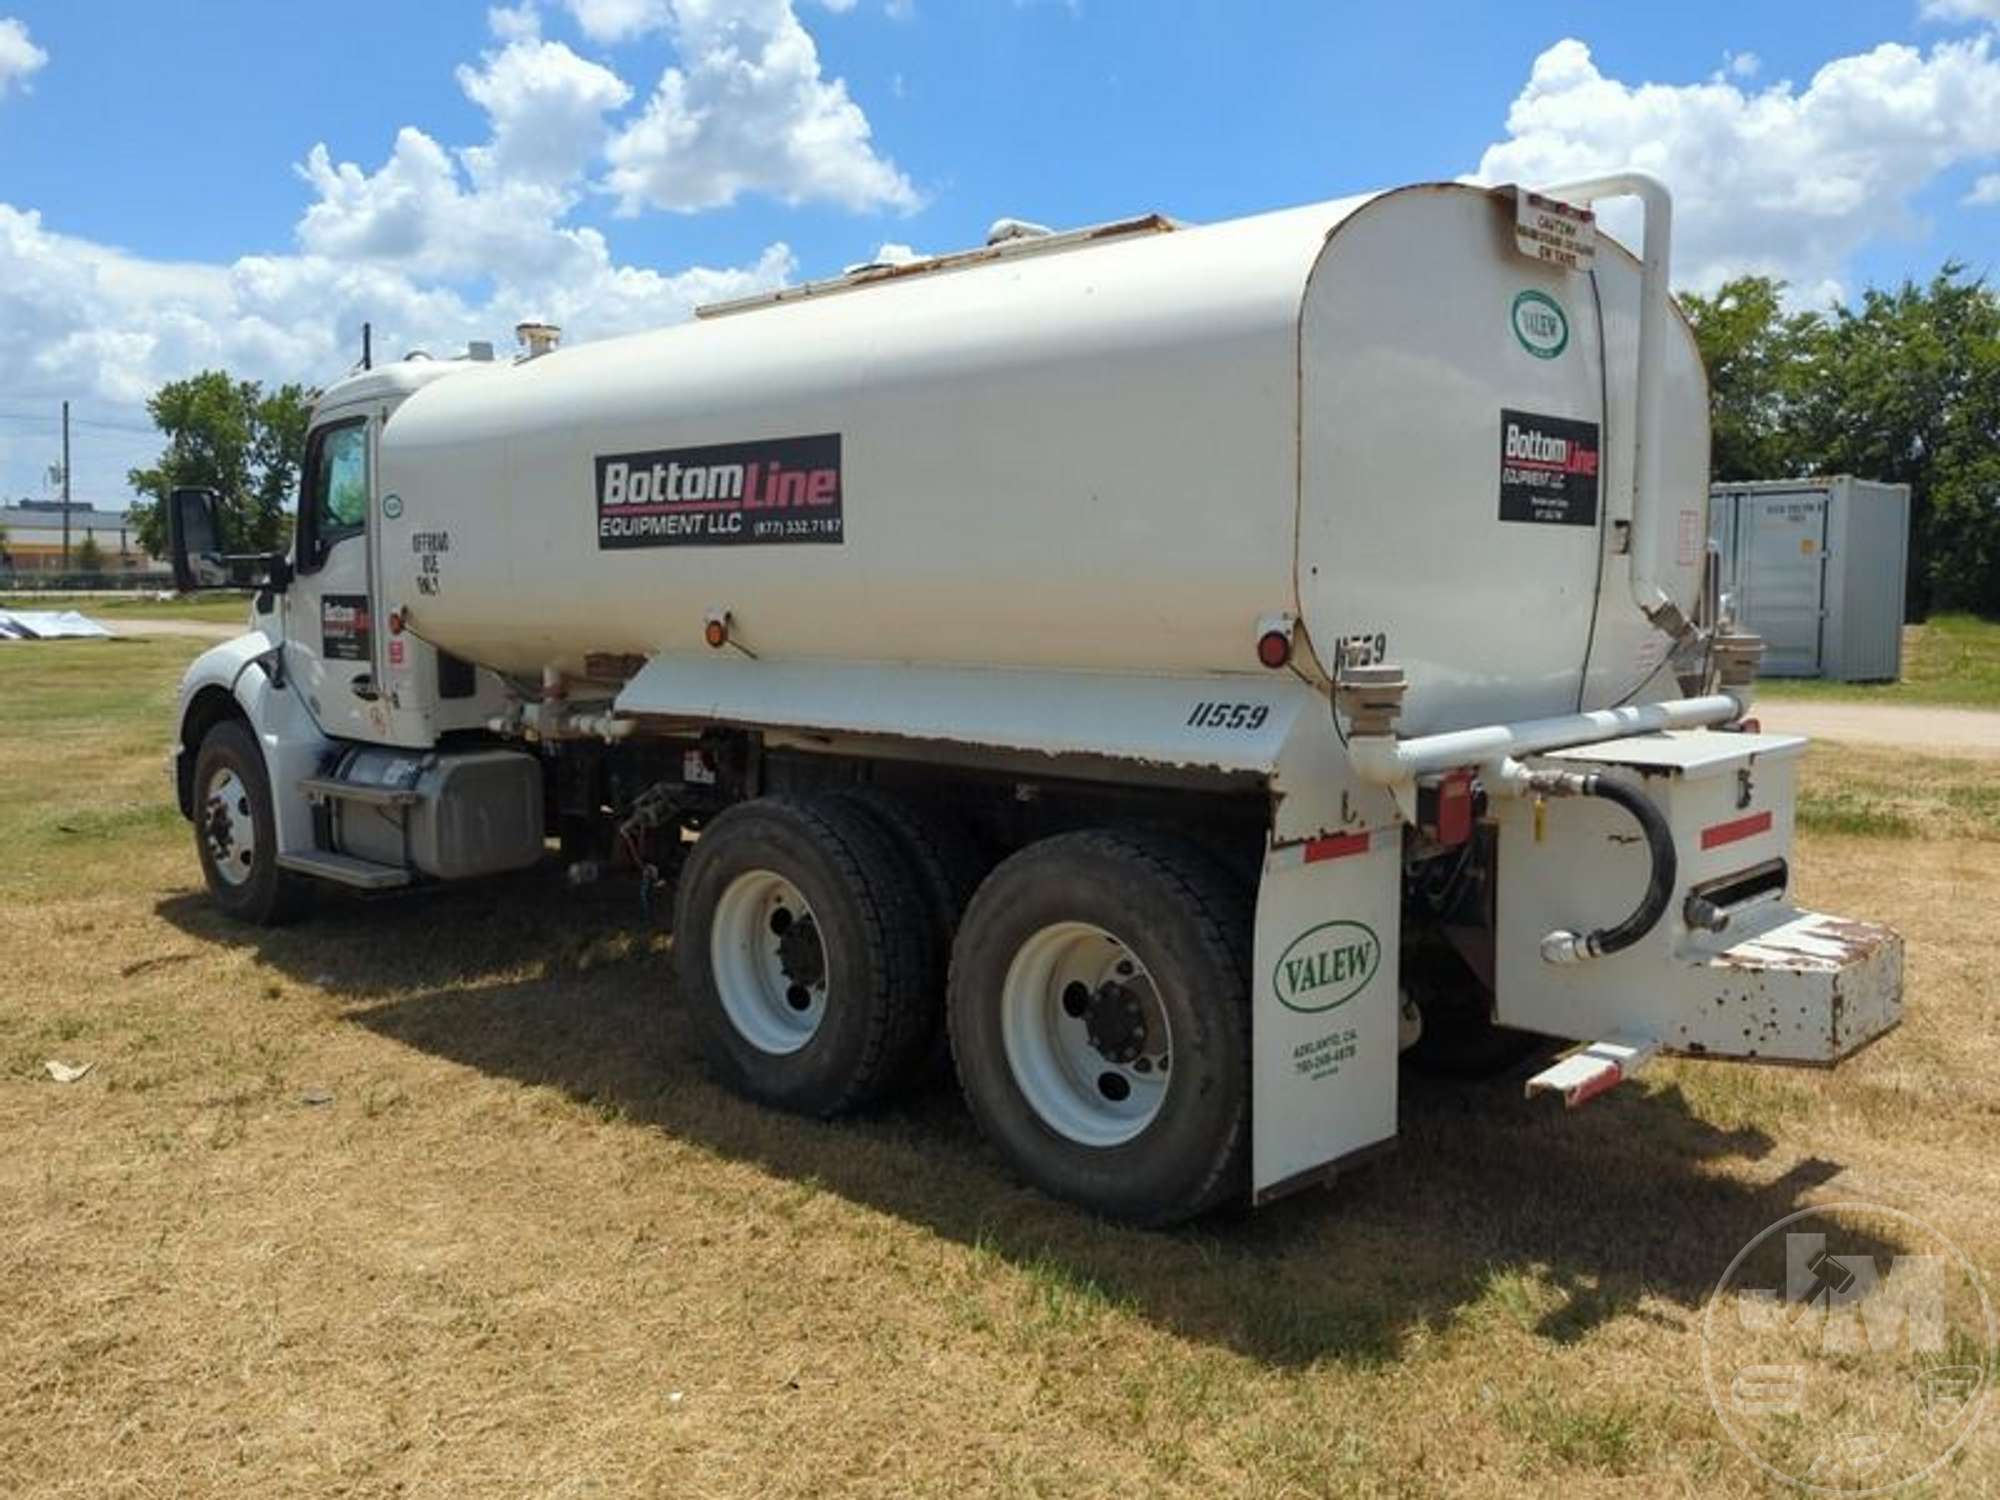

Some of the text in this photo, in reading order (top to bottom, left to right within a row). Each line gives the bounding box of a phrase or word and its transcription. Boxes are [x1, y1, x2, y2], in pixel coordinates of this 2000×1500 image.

[600, 512, 742, 537] EQUIPMENT LLC
[1187, 701, 1270, 730] 11559
[1285, 941, 1373, 996] VALEW
